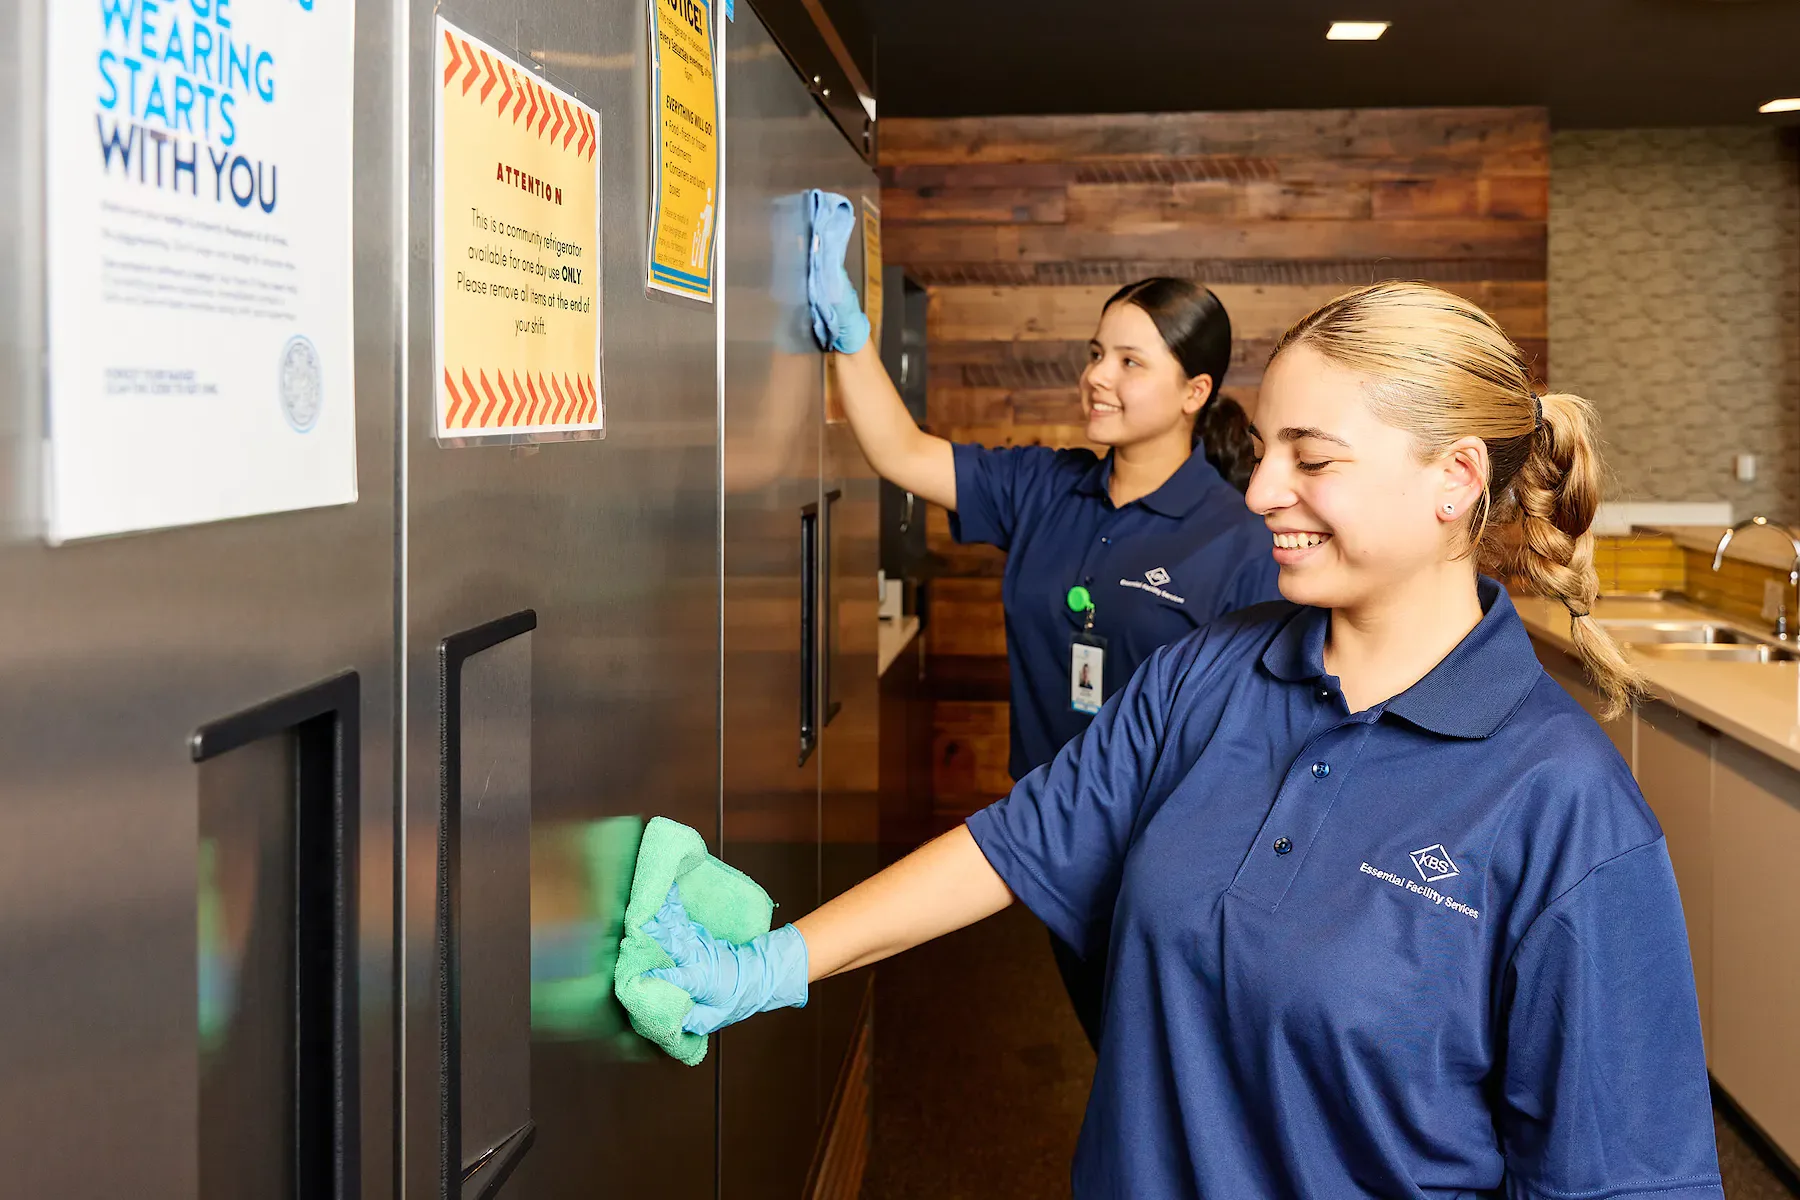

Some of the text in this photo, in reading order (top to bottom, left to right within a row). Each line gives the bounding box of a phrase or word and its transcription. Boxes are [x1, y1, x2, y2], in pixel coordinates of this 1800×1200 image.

[664, 0, 703, 36] TICE!
[100, 0, 275, 103] WEARING
[96, 49, 237, 147] STARTS
[666, 94, 713, 138] EVERYTHING WILL GO!
[669, 119, 679, 136] Food
[96, 112, 278, 214] WITH YOU
[669, 140, 692, 163] Condiments
[669, 161, 689, 182] Containers
[496, 162, 563, 206] ATTENTION
[471, 207, 583, 258] This is a community refrigerator
[468, 243, 584, 286] available for one day use ONLY.
[457, 270, 590, 314] Please remove all items at the end of
[514, 315, 547, 337] your shift.
[1419, 851, 1450, 874] KBS
[1359, 861, 1480, 920] Essential Facility Services
